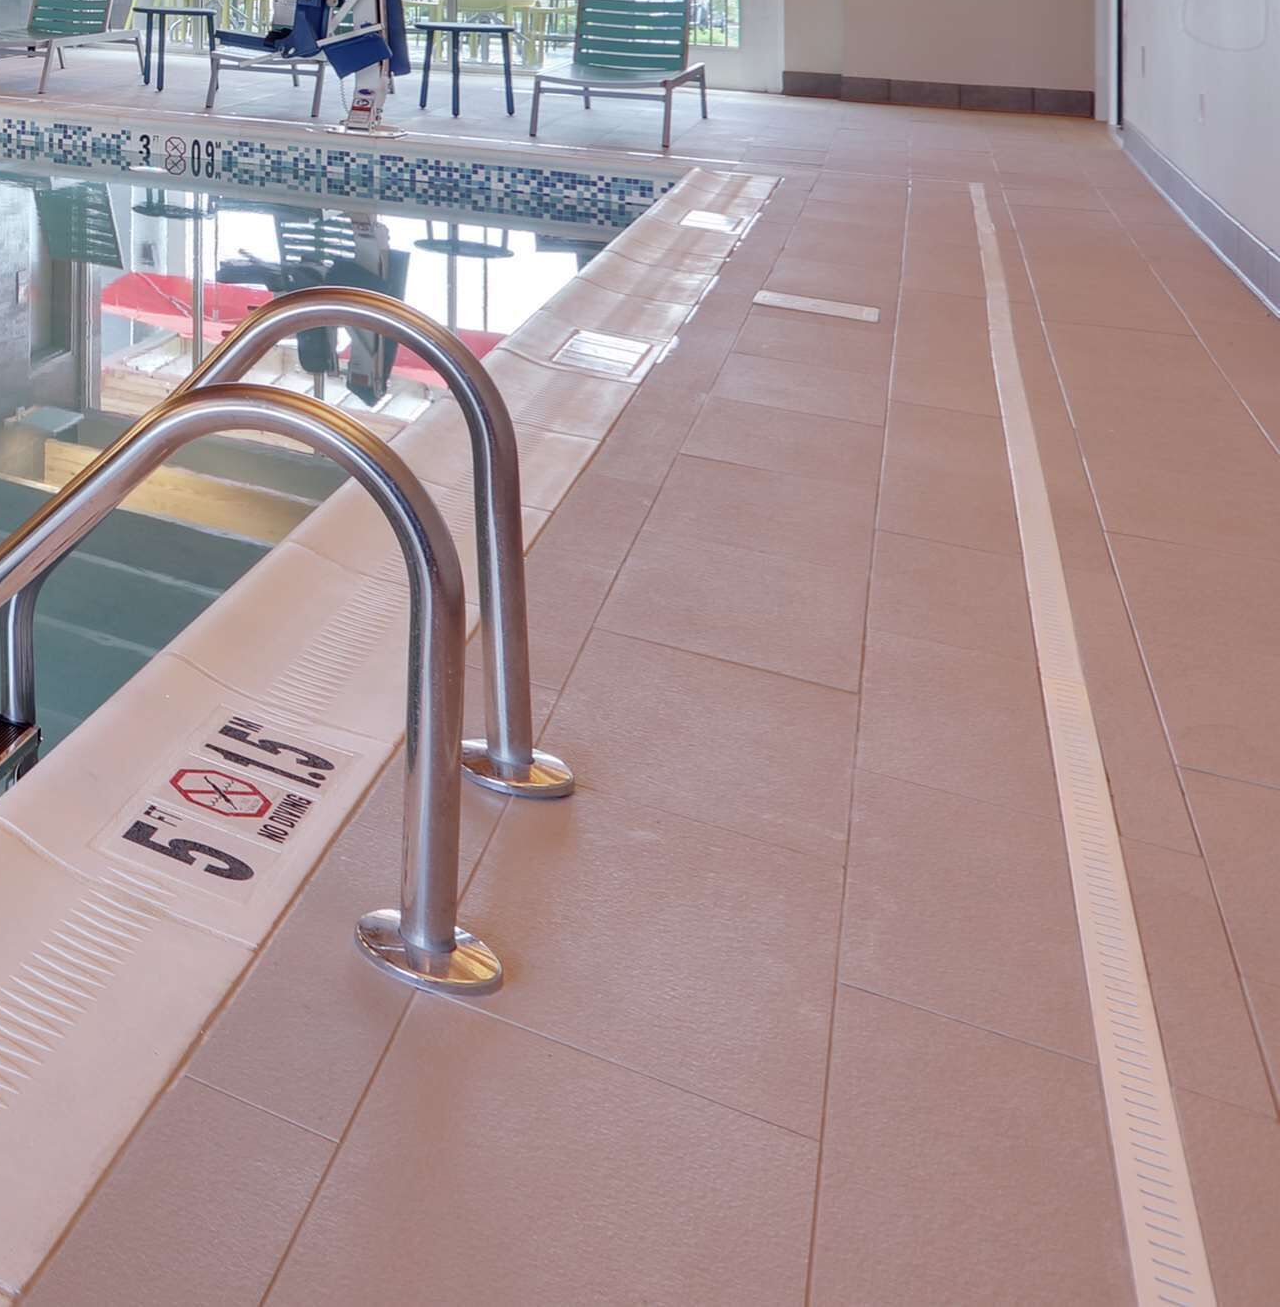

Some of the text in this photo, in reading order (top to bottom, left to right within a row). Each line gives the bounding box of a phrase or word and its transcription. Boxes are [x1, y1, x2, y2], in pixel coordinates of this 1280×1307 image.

[138, 134, 151, 155] 3
[122, 716, 335, 881] 5 FT 1.5 M
[257, 793, 314, 844] NO DIVING
